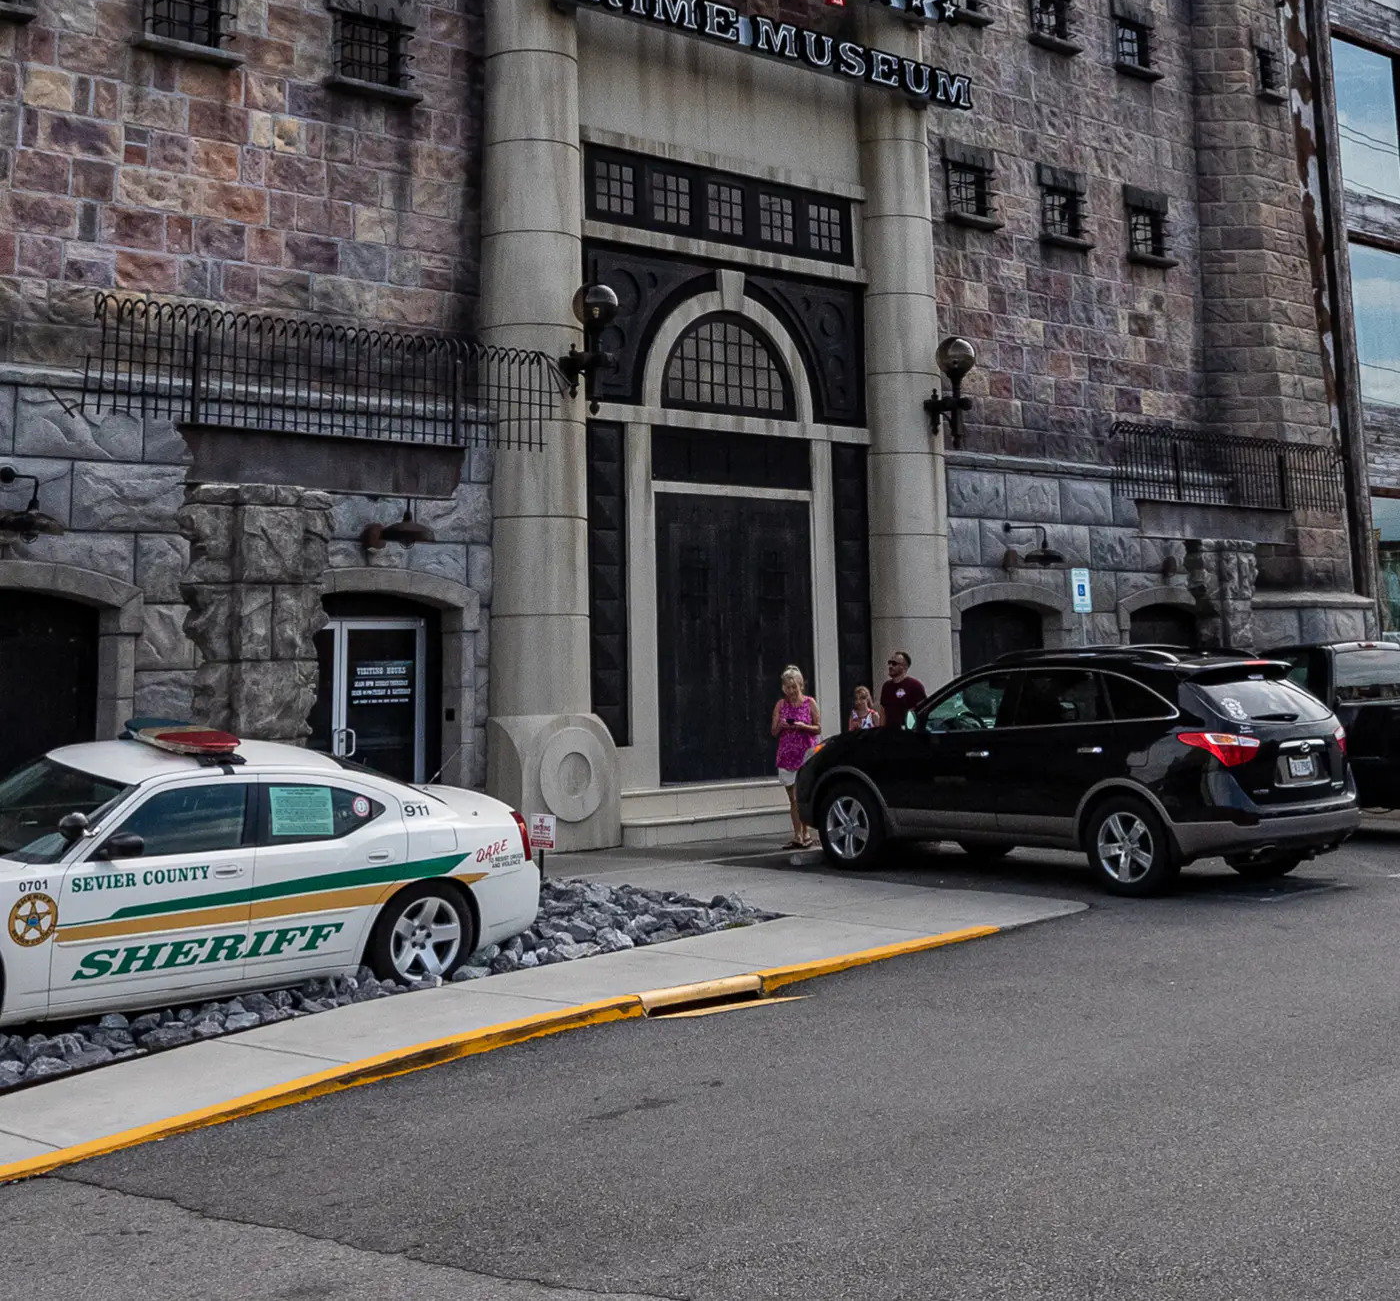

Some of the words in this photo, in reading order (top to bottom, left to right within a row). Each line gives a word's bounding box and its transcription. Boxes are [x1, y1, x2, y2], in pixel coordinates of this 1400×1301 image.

[750, 16, 973, 110] MUSEUM
[356, 667, 384, 675] VISITING
[386, 667, 406, 675] HOURS
[404, 805, 430, 817] 911
[476, 839, 508, 863] DARE
[19, 879, 48, 892] 0701
[71, 872, 137, 893] SEVIER
[143, 865, 210, 886] COUNTY
[71, 922, 345, 981] SHERIFF
